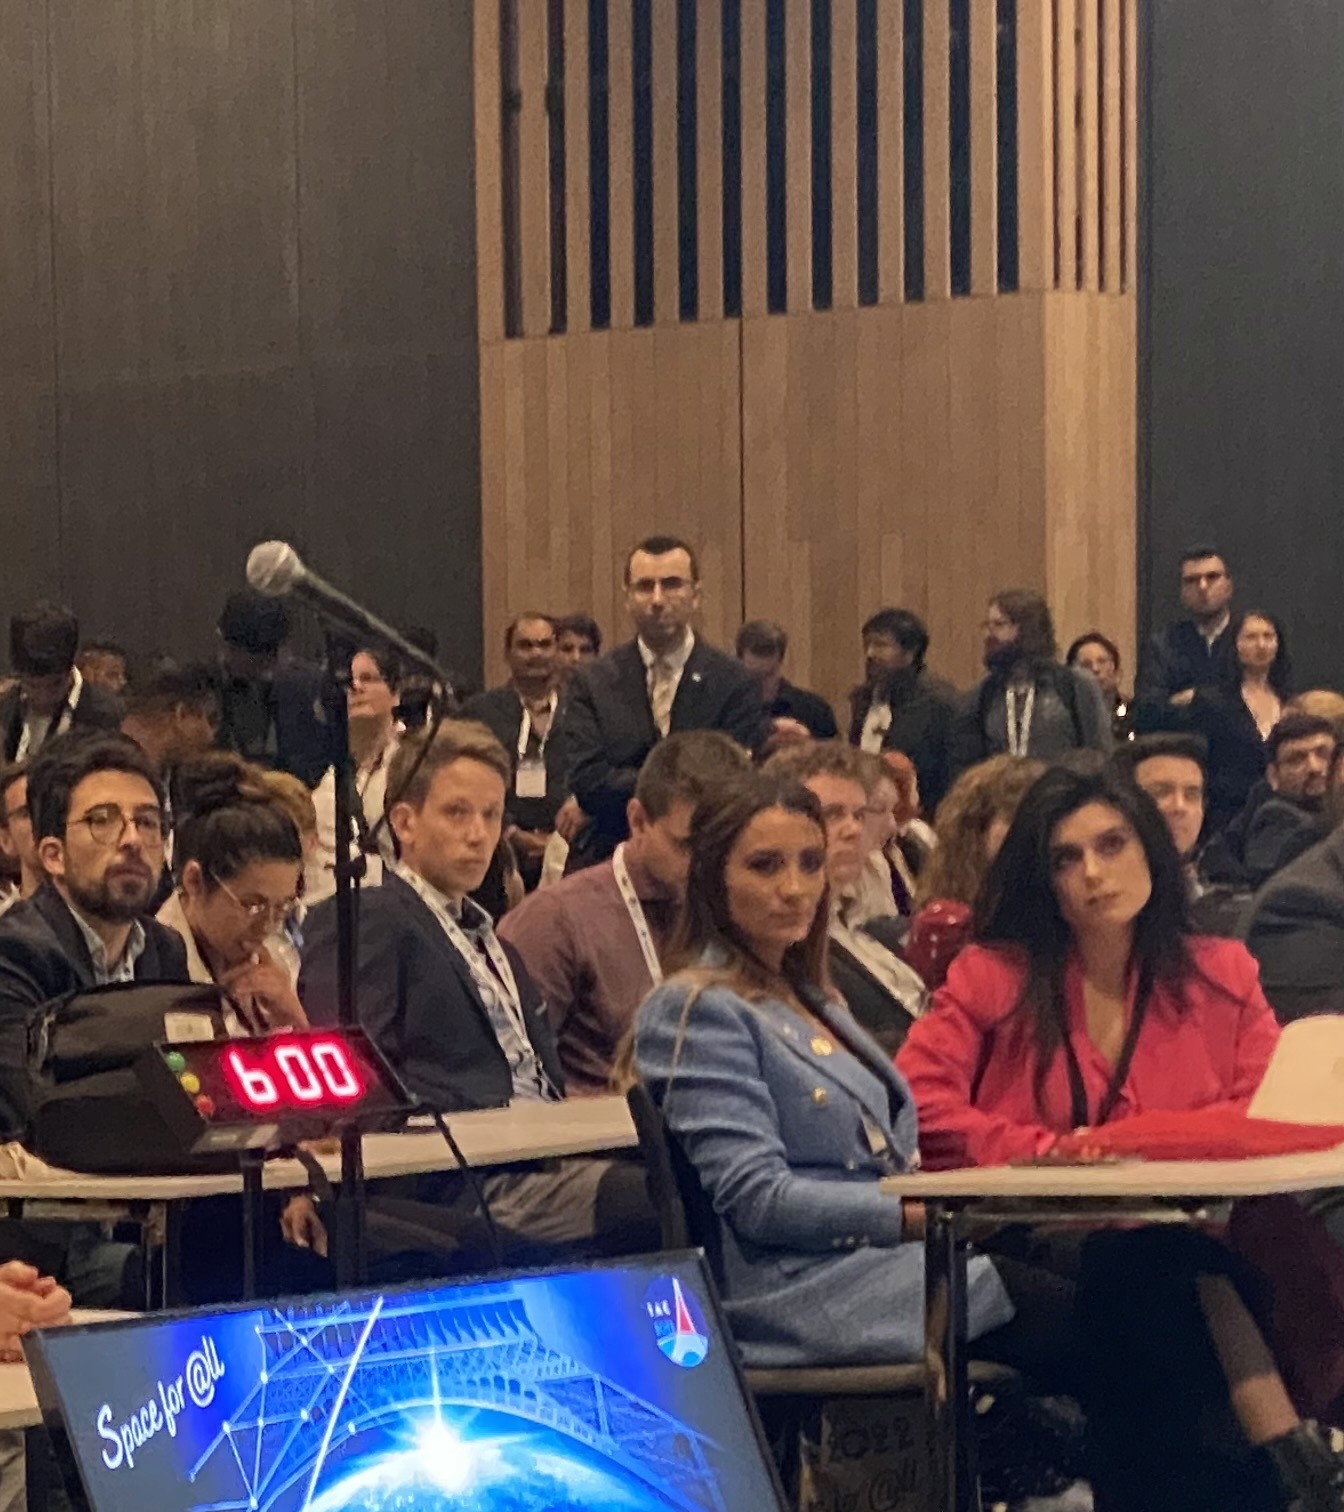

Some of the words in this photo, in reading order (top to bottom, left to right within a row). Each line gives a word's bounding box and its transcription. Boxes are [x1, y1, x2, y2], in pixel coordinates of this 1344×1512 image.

[97, 1402, 164, 1470] Space
[157, 1375, 186, 1438] for
[186, 1335, 226, 1408] @ll
